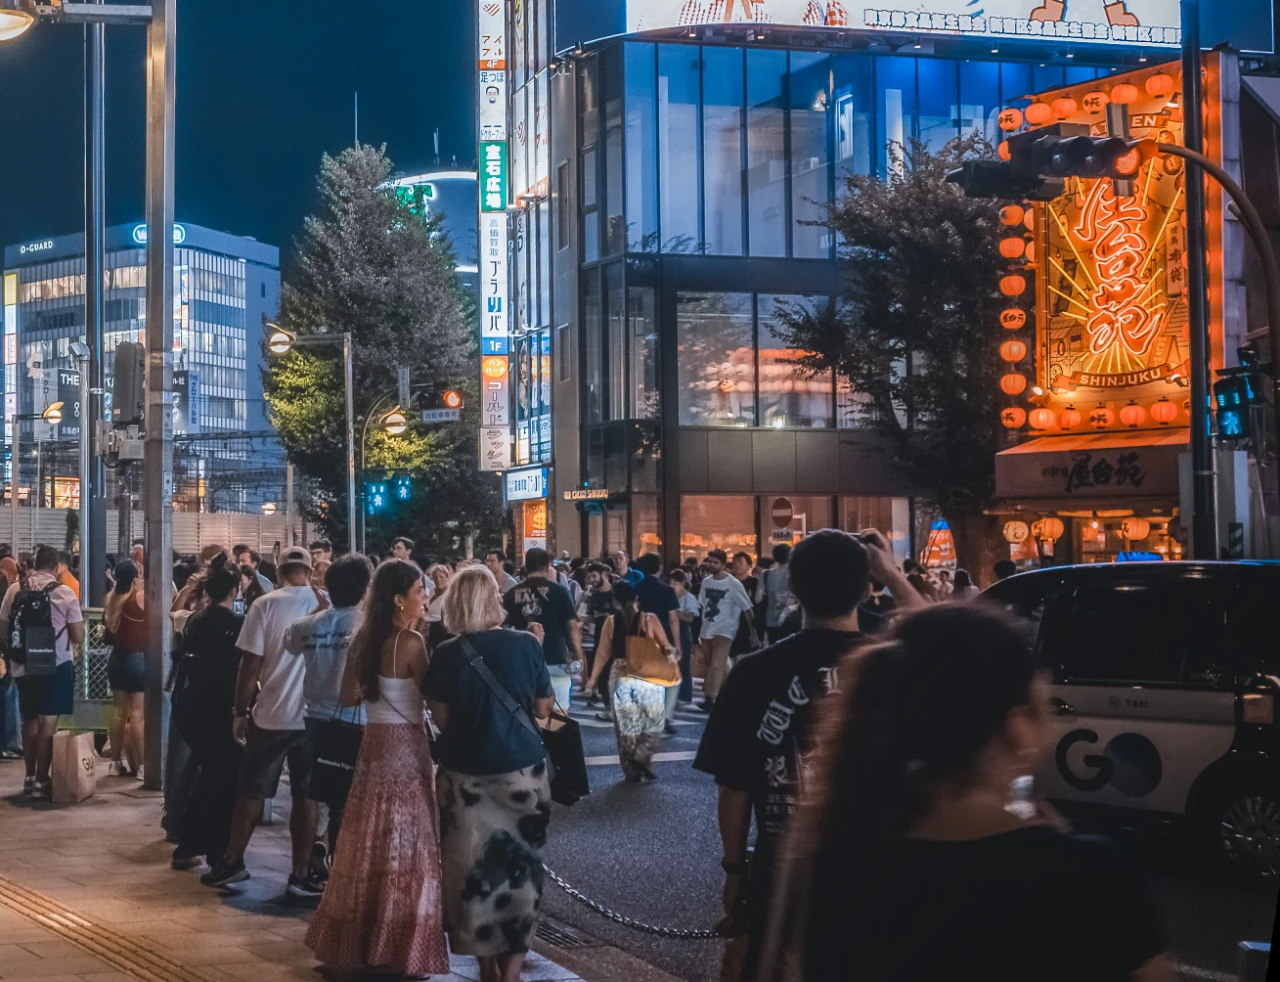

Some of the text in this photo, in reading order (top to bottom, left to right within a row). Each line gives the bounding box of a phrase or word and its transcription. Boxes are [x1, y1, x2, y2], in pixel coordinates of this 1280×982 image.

[481, 35, 503, 45] アイ
[481, 48, 504, 57] フル
[486, 60, 499, 69] 4F
[480, 71, 505, 84] 足つぼ
[485, 144, 502, 209] 宝石広場
[489, 218, 499, 257] 高価買取
[20, 240, 53, 254] O-GUARD
[487, 260, 502, 332] ブラリバ
[489, 340, 502, 352] 1F
[1079, 367, 1161, 387] SHINJUKU
[1125, 699, 1149, 709] TAXI
[81, 755, 95, 772] GU
[1054, 727, 1163, 798] GO
